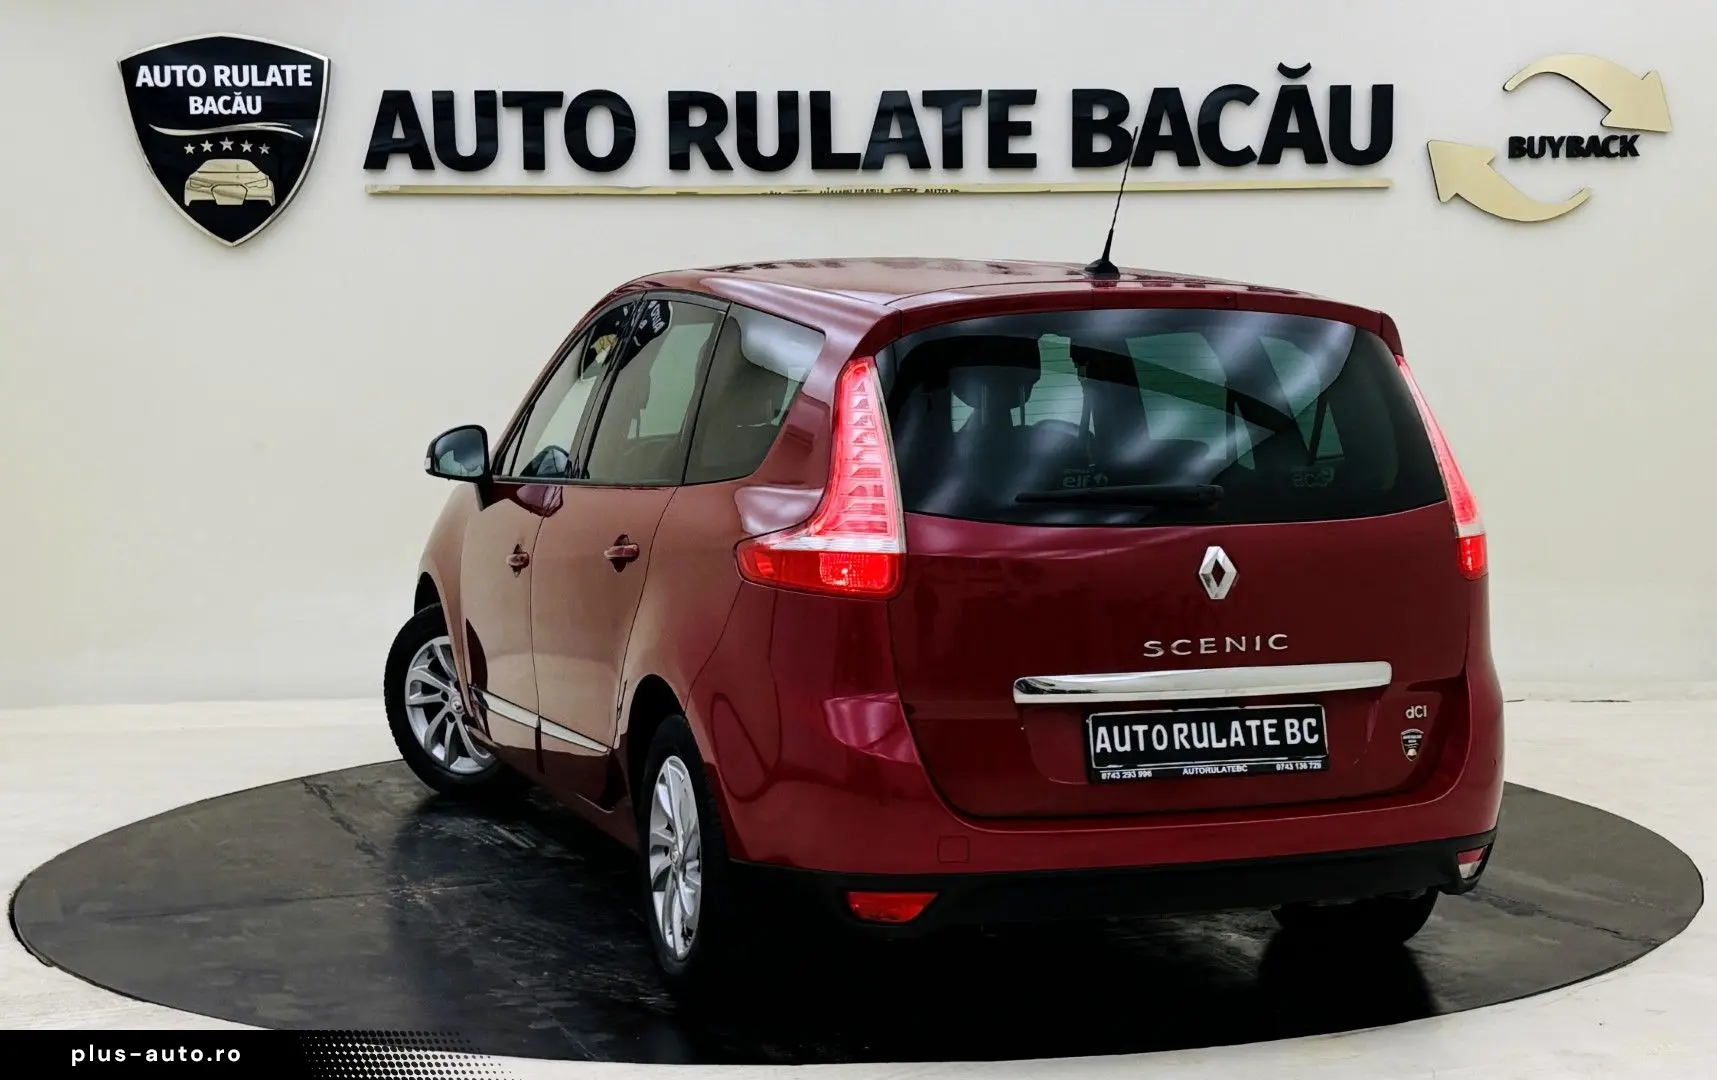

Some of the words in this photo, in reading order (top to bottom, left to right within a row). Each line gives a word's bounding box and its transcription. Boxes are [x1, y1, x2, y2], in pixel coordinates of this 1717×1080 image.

[136, 64, 207, 88] AUTO
[213, 64, 313, 87] RULATE
[188, 91, 263, 115] BACĂU
[364, 89, 636, 173] AUTO
[668, 88, 1037, 172] RULATE
[1072, 62, 1394, 168] BACĂU
[1508, 134, 1640, 159] BUYBACK
[1143, 633, 1290, 658] SCENIC
[1285, 717, 1320, 745] BC
[1182, 764, 1248, 776] AUTORULATEBC
